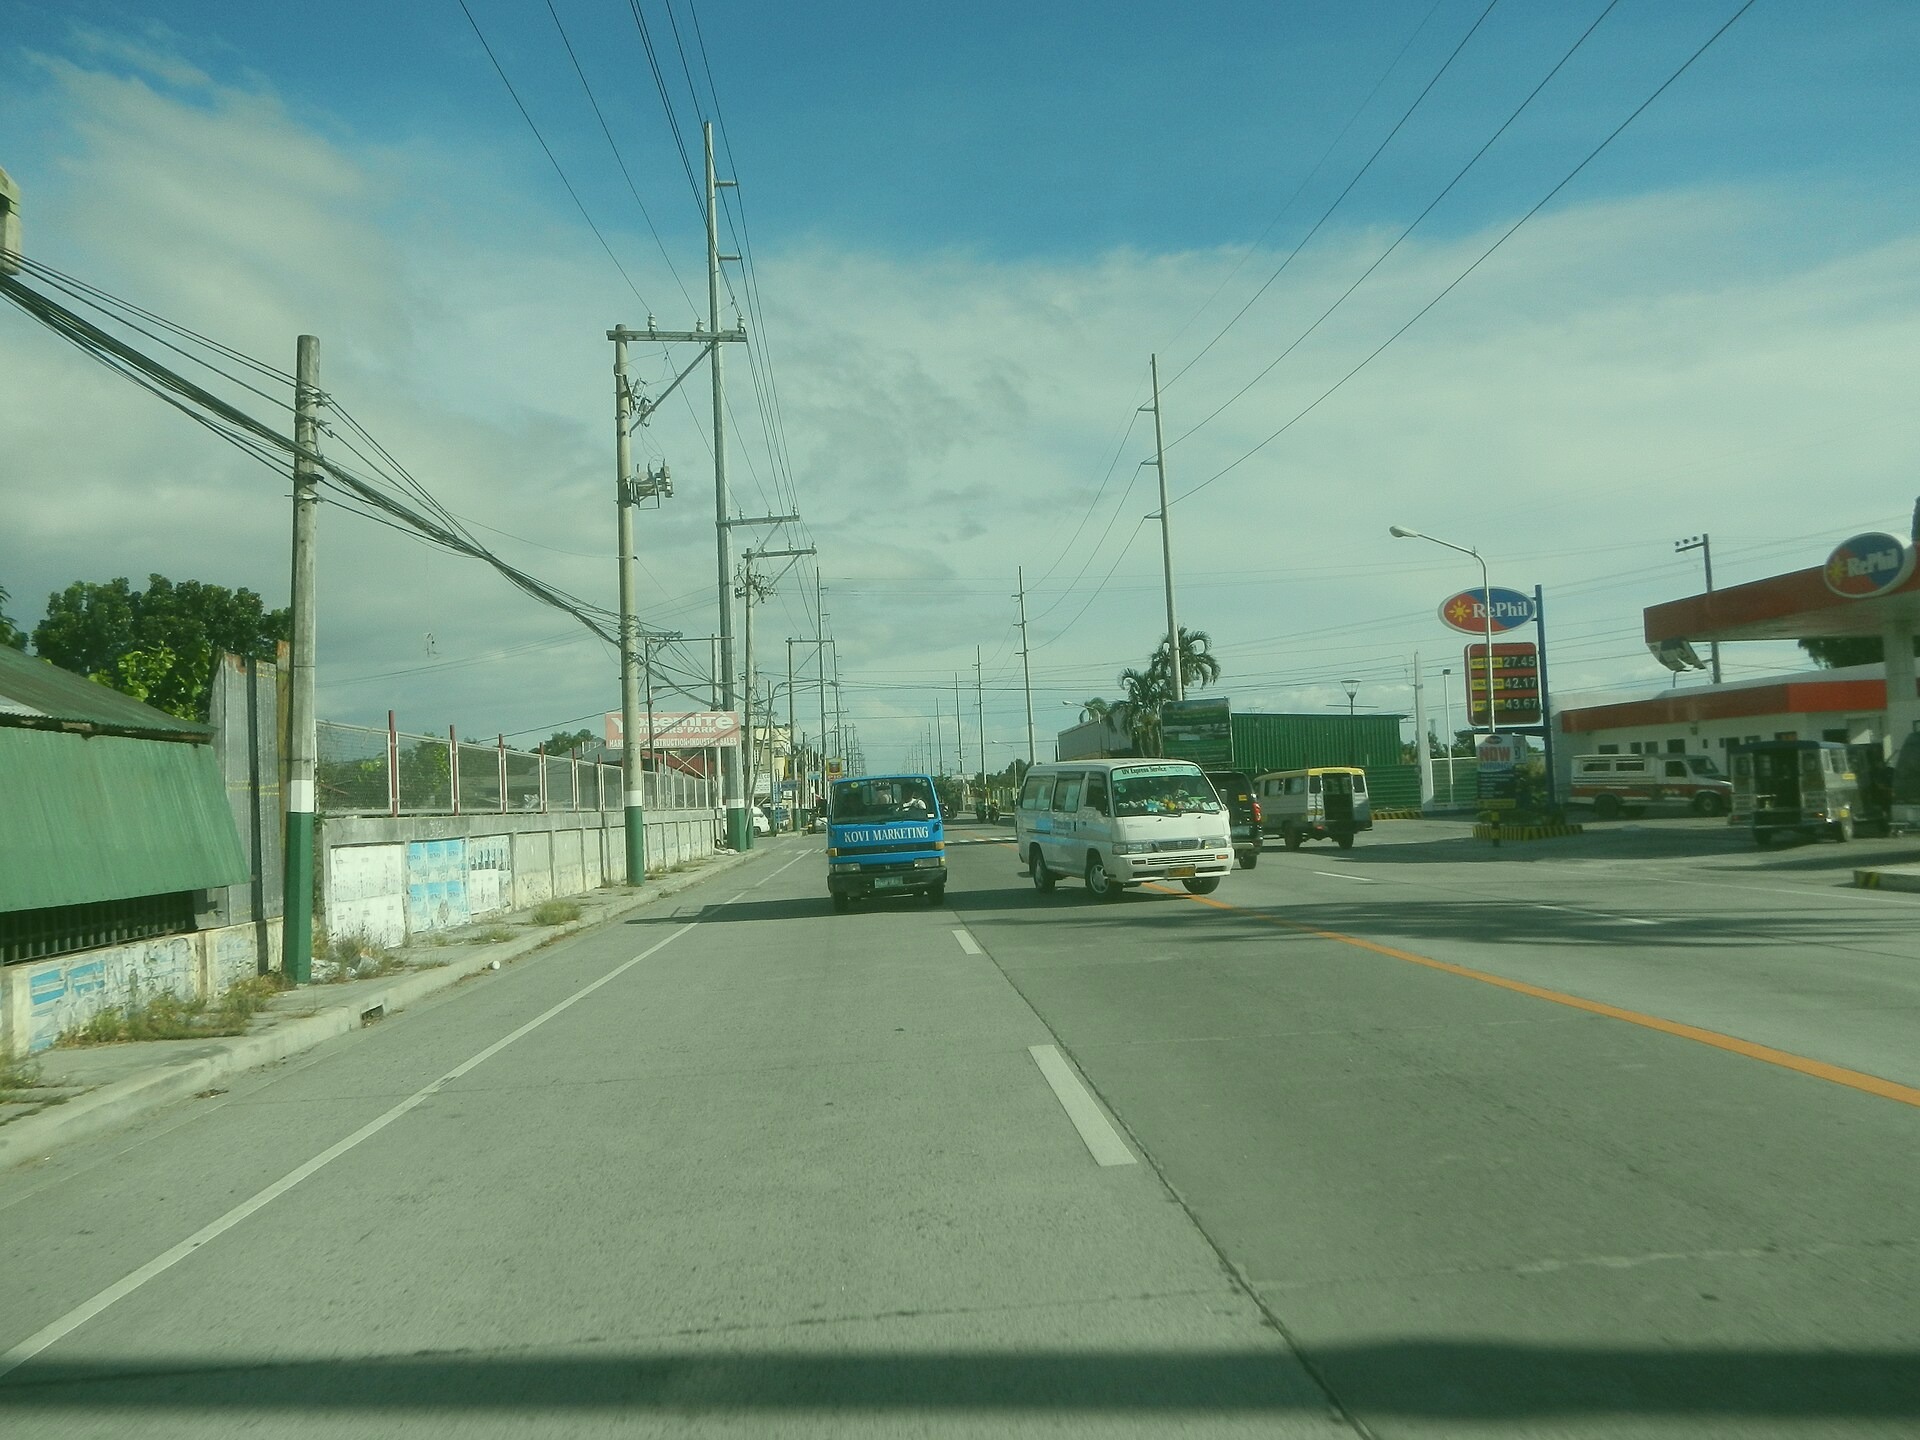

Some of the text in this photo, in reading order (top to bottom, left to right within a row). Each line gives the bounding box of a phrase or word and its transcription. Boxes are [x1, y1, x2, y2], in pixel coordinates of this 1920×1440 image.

[1472, 601, 1528, 618] RePhil
[1503, 656, 1536, 667] 27.45
[1505, 677, 1537, 688] 42.17
[1506, 698, 1538, 709] 43.67
[687, 726, 717, 734] PARK
[720, 737, 738, 746] SALES
[1479, 746, 1511, 761] NOW
[1130, 767, 1149, 775] Express
[844, 826, 929, 843] KOVI MARKETING
